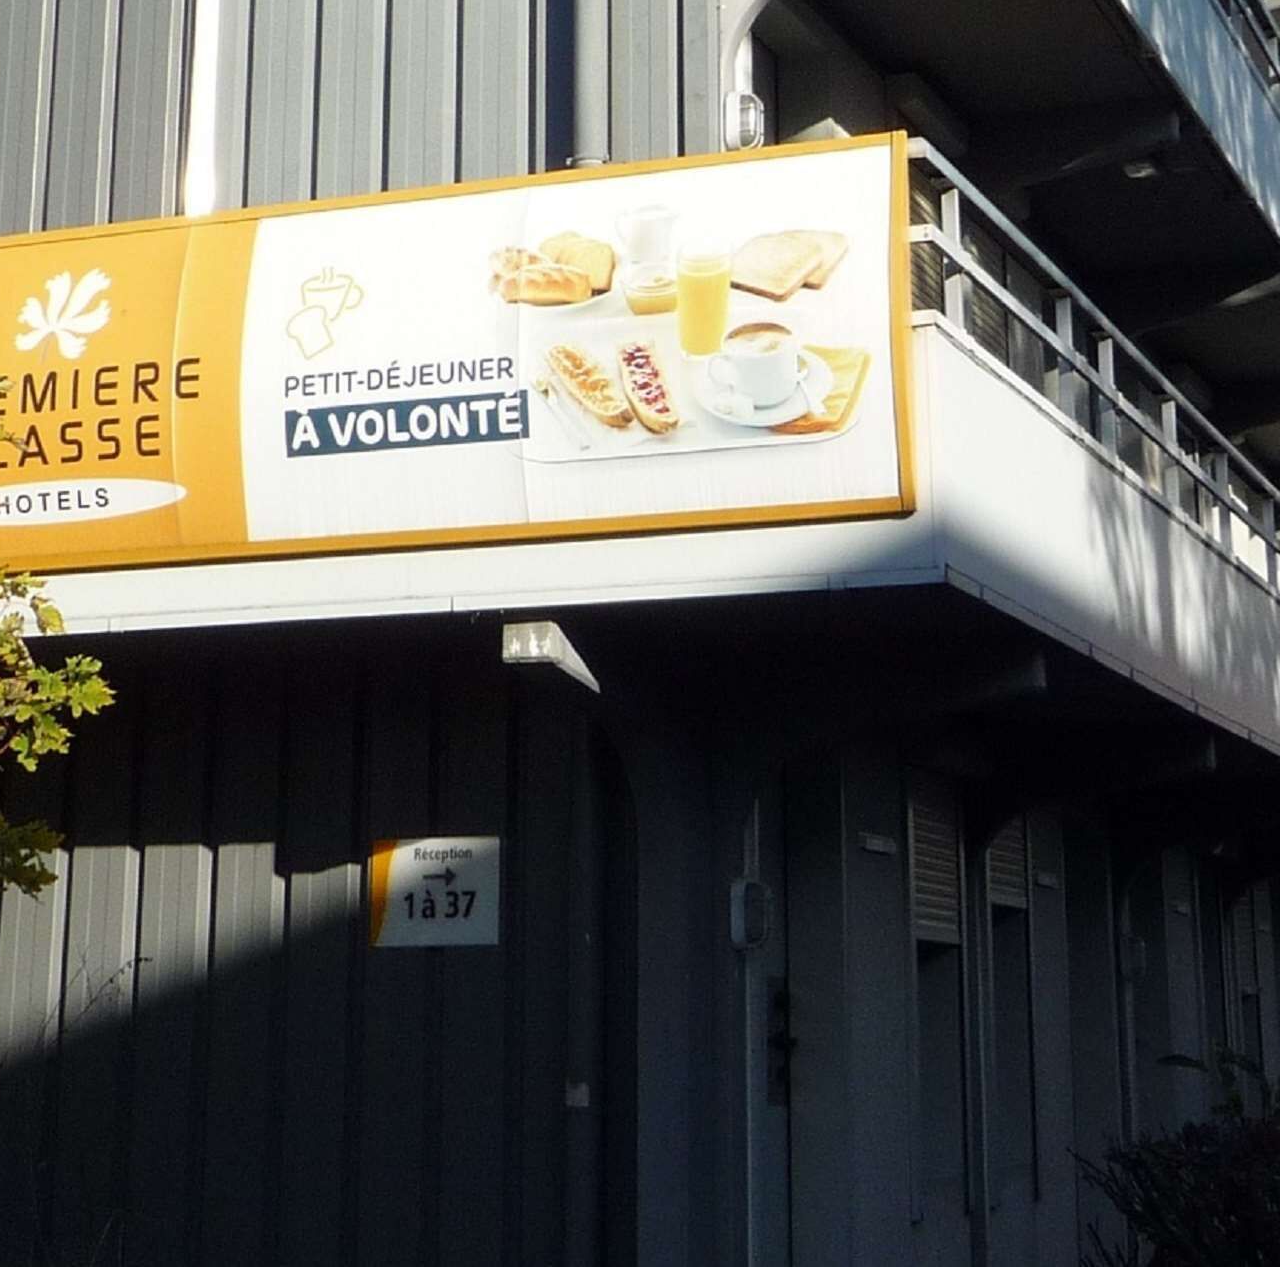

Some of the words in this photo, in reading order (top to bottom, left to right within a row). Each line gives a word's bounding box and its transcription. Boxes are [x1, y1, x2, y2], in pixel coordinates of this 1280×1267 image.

[285, 357, 514, 397] PETIT-DÉJEUNER
[292, 399, 320, 450] À
[328, 392, 523, 446] VOLONTÉ
[404, 892, 415, 920] 1
[422, 890, 436, 919] à
[444, 890, 477, 919] 37
